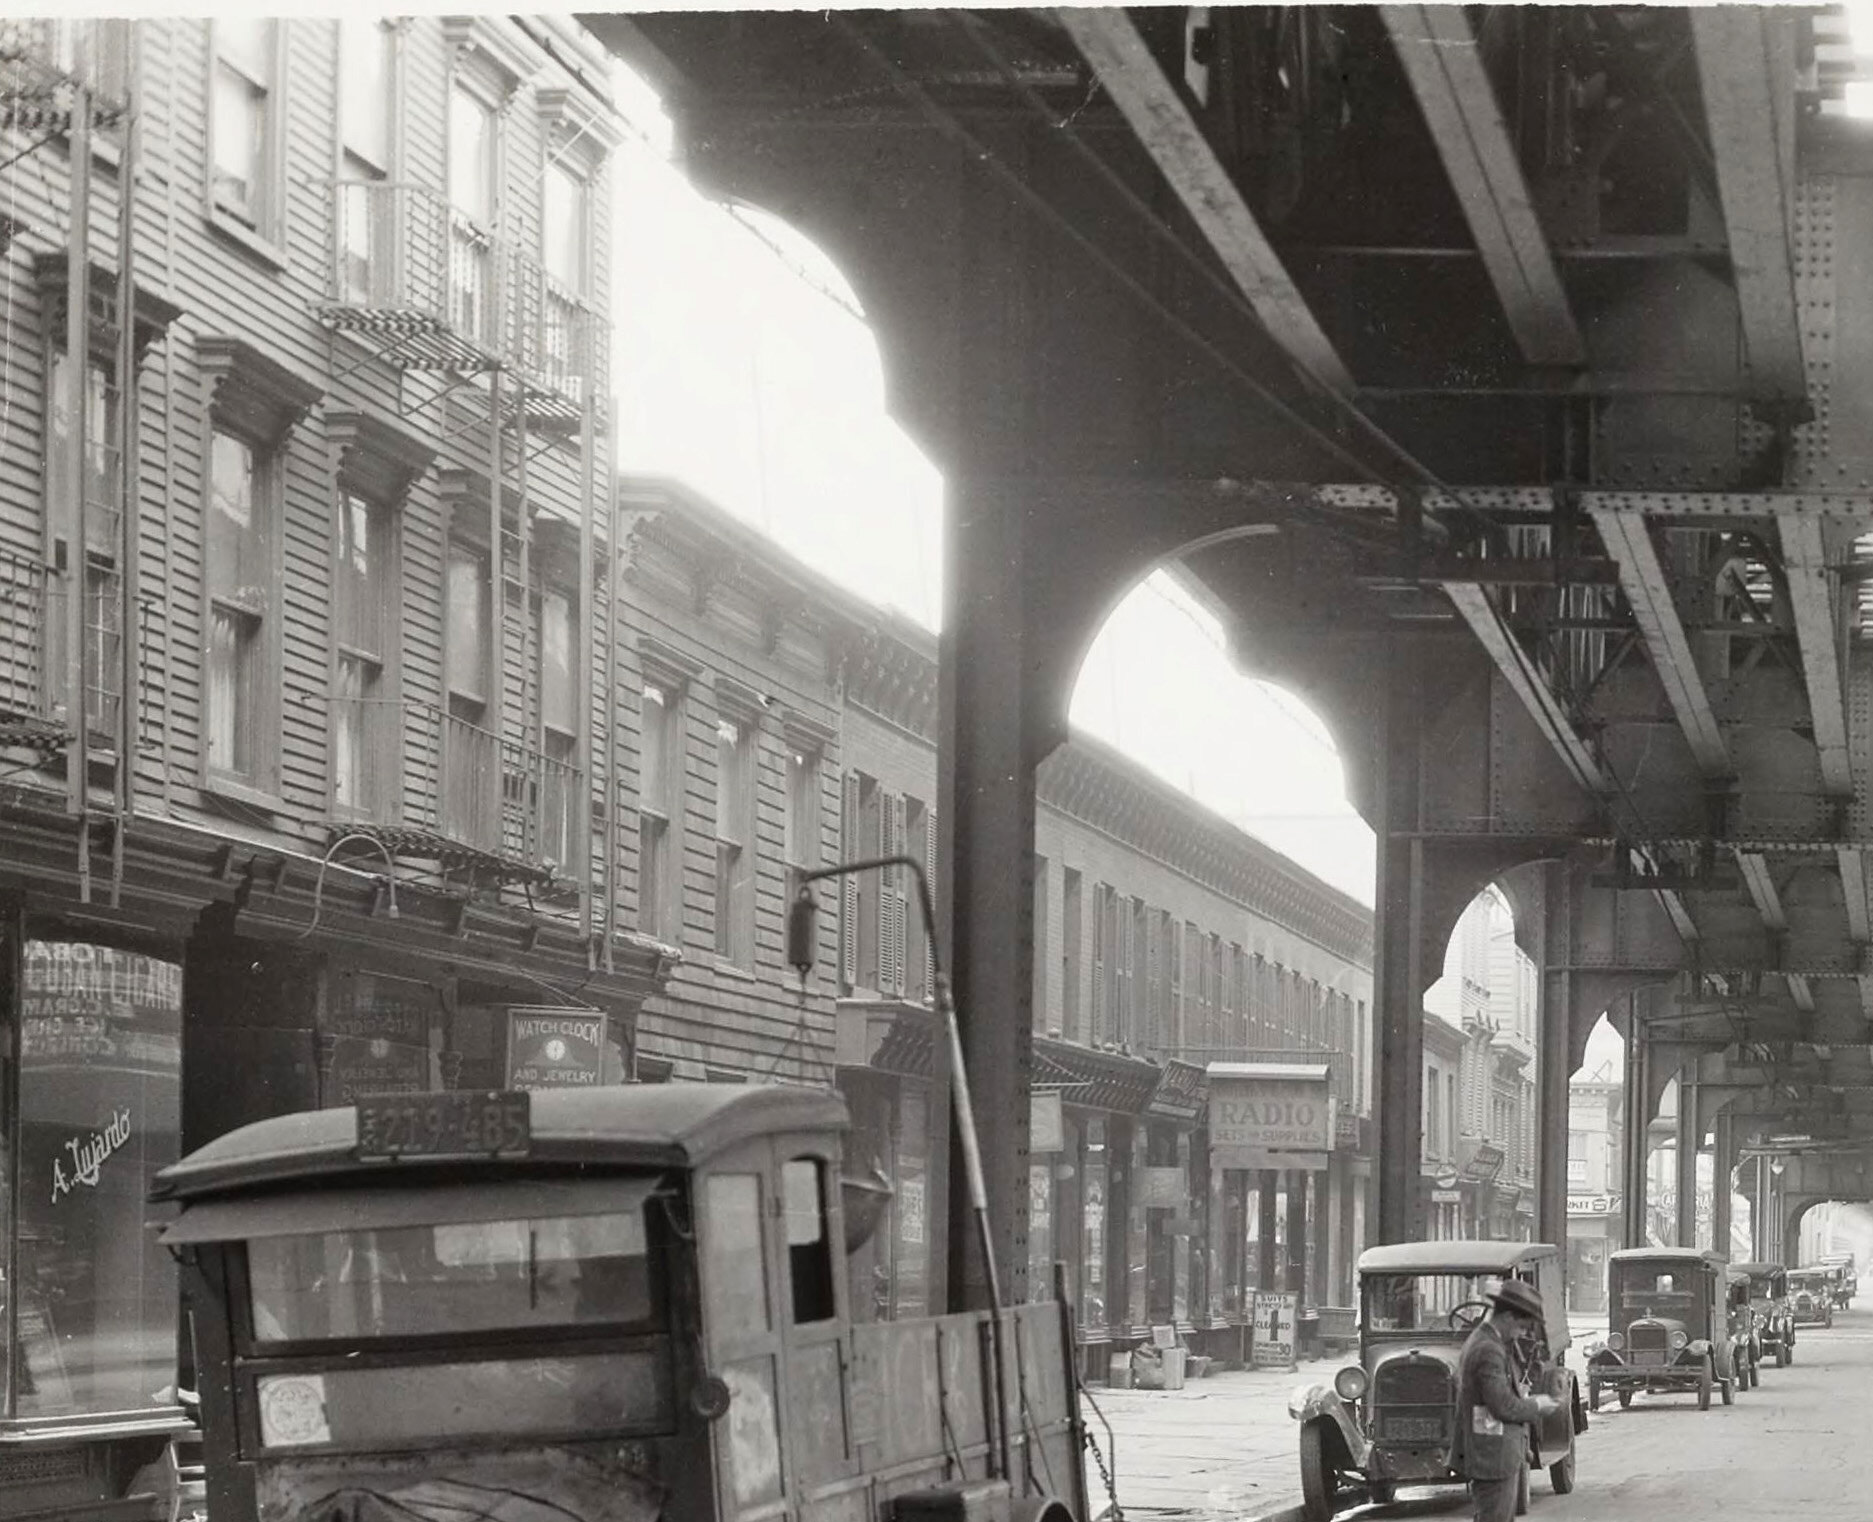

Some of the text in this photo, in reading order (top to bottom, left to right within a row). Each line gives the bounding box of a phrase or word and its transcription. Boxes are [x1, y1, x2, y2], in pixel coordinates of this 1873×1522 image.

[515, 1020, 600, 1047] WATCH CLOCK
[514, 1068, 596, 1082] AND JEWELRY
[1220, 1102, 1315, 1127] RADIO
[1215, 1129, 1246, 1141] SETS
